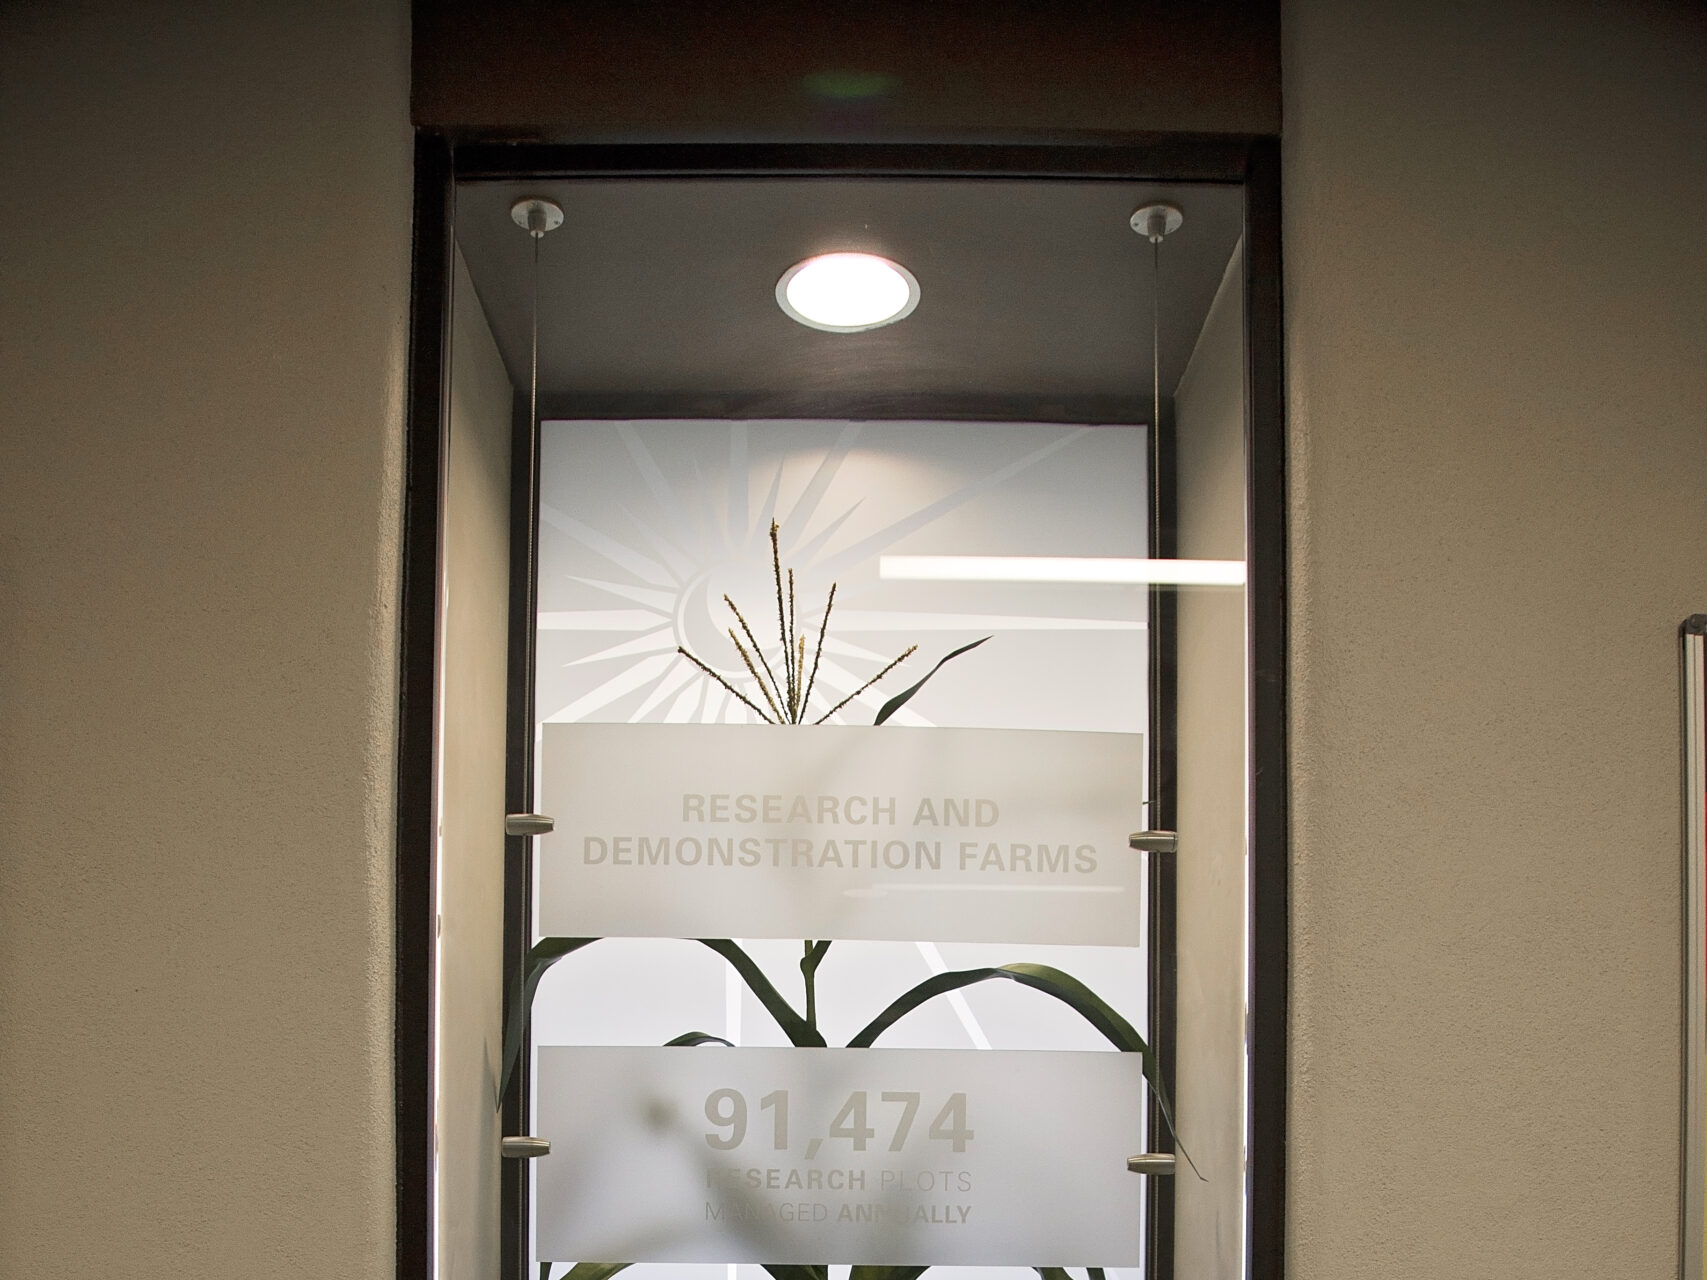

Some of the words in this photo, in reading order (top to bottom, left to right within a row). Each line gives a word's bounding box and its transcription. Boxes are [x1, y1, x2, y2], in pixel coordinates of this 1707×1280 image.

[681, 792, 897, 827] RESEARCH
[912, 797, 1000, 829] AND
[583, 835, 942, 870] DEMONSTRATION
[957, 841, 1098, 874] FARMS
[704, 1087, 975, 1161] 91,474
[880, 1169, 972, 1192] PLOTS
[705, 1201, 828, 1223] MGED
[837, 1203, 972, 1224] ANALLY
